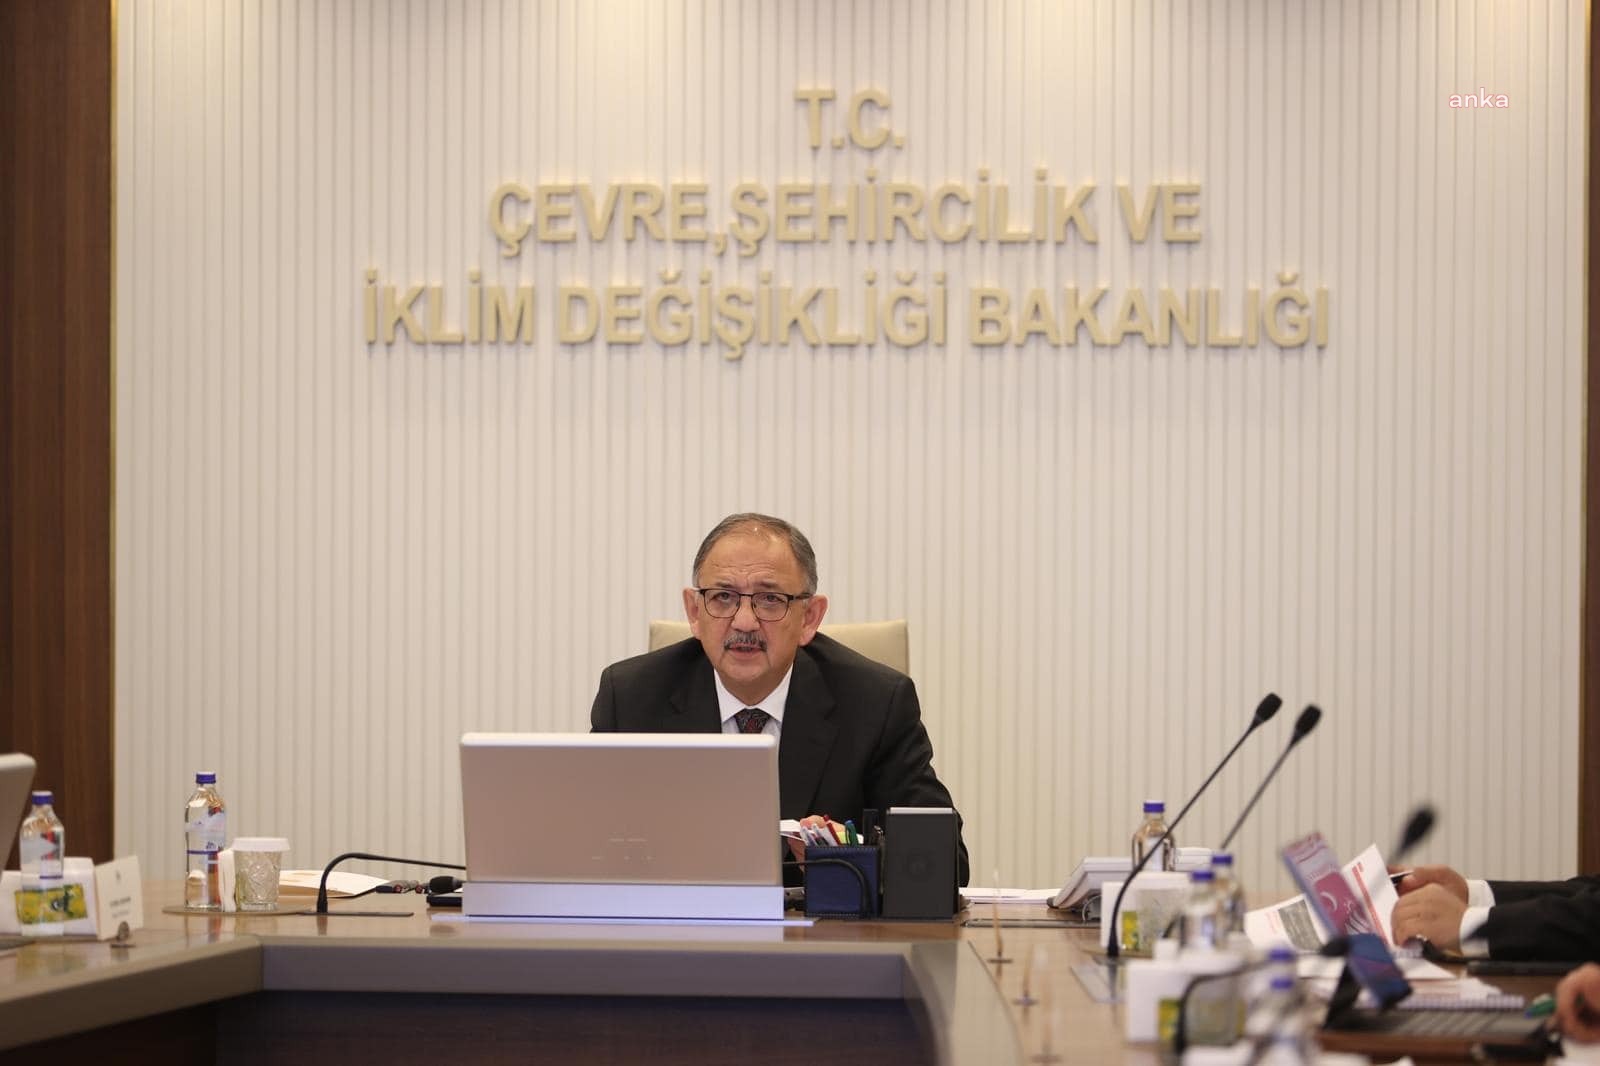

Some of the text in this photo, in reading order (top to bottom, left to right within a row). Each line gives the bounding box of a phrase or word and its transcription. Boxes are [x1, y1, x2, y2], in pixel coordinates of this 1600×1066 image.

[794, 87, 905, 150] T.C.
[1117, 183, 1202, 244] VE
[364, 268, 1329, 361] İKLİM DEĞİŞİKLİĞİ BAKANLIĞI
